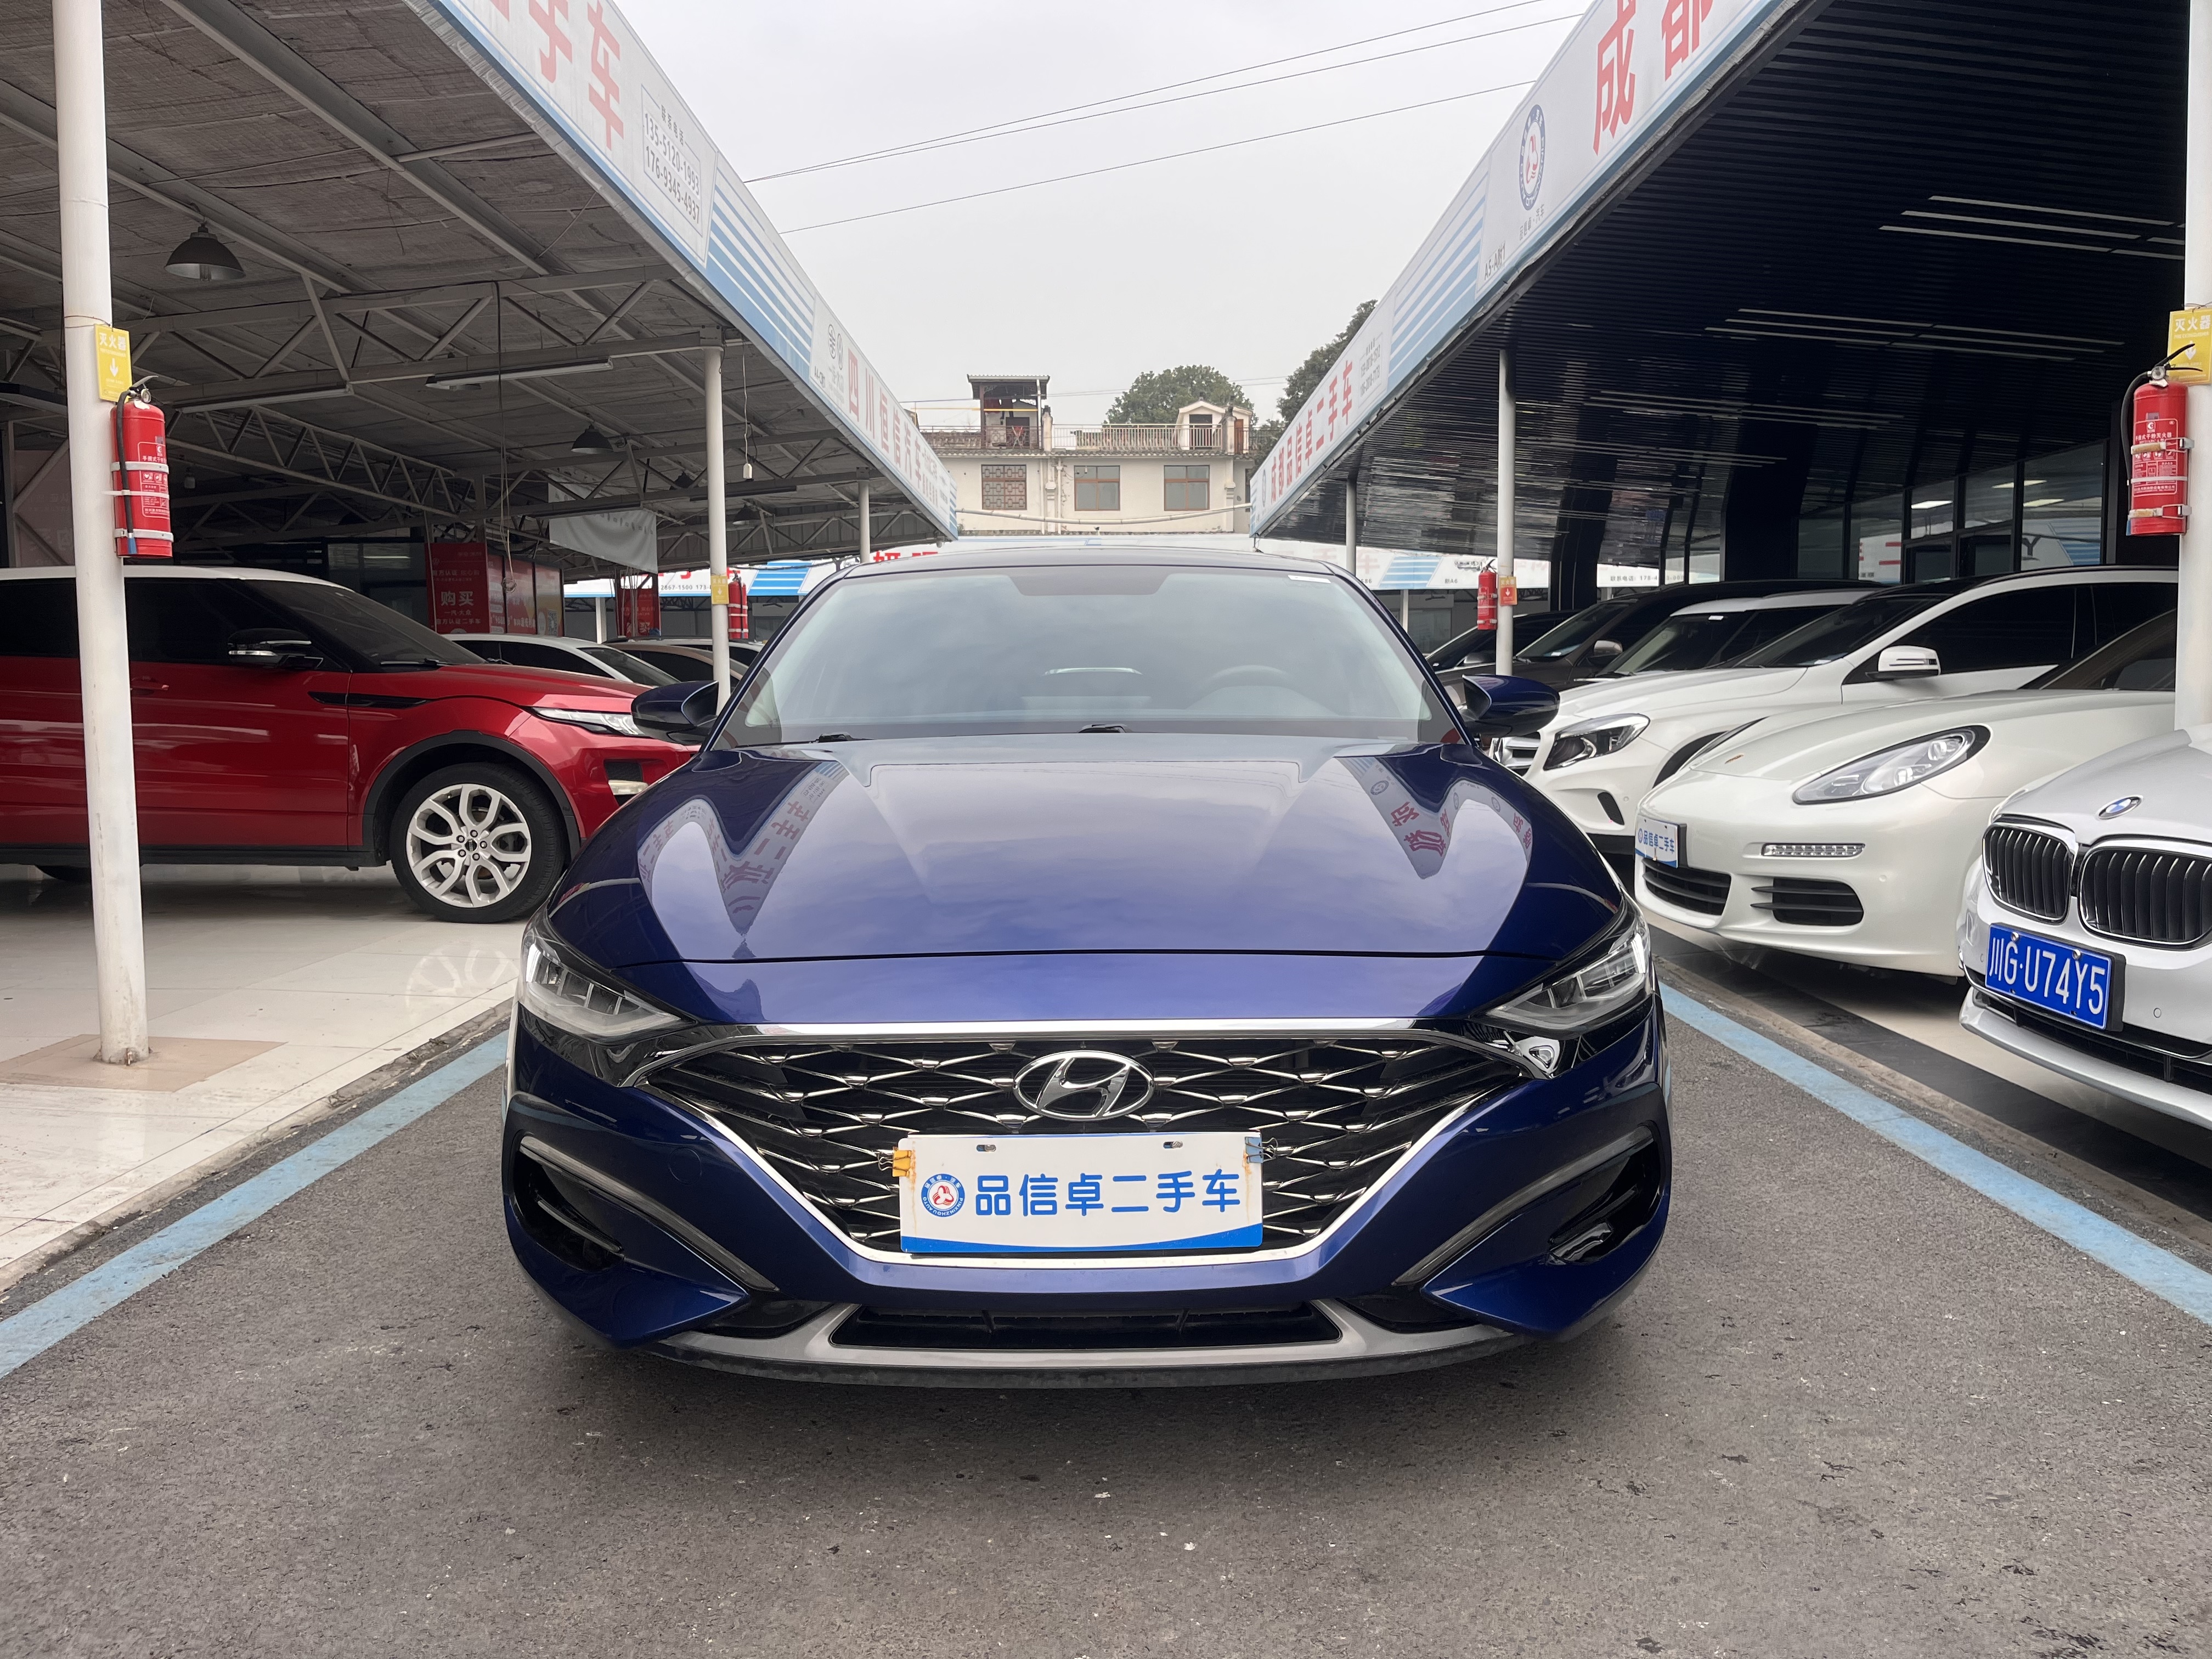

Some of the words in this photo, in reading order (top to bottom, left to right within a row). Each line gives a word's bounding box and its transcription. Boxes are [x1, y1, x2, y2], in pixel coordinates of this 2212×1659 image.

[645, 114, 699, 195] 135-5120-1993
[646, 146, 699, 224] 176-9345-4937
[99, 332, 126, 351] 灭火器
[2175, 315, 2210, 332] 灭火器
[1271, 360, 1353, 504] 成都品信卓二手车
[441, 591, 474, 606] 购买
[1644, 830, 1674, 855] 品信卓二手车
[975, 1169, 1240, 1216] 品信卓二手车
